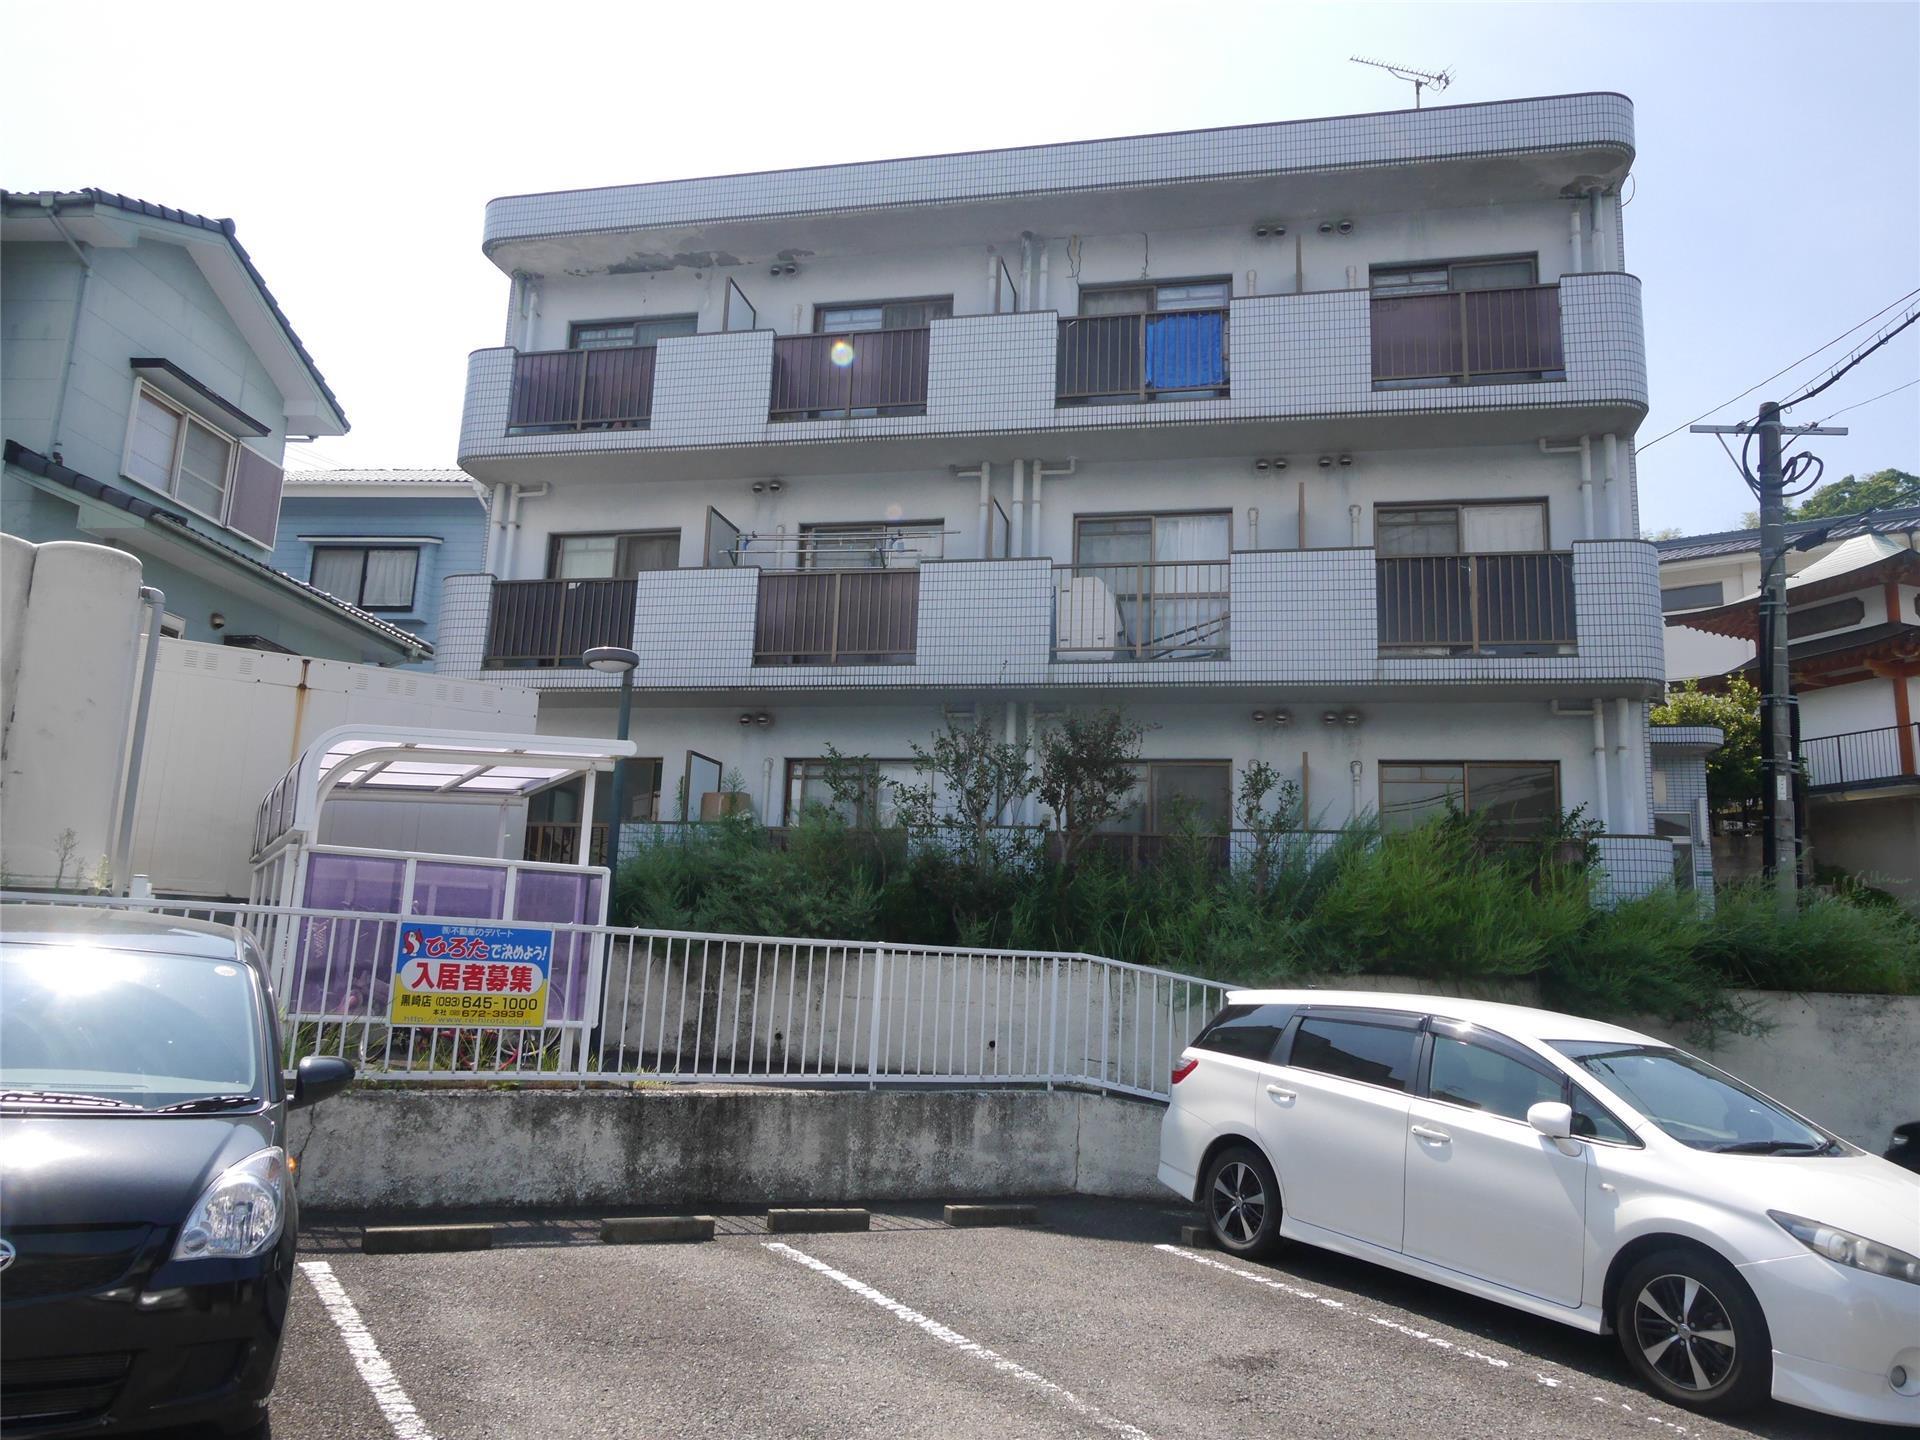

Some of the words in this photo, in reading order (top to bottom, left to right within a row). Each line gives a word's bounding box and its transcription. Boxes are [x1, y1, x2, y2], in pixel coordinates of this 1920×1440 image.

[411, 962, 533, 993] 入居者募集
[401, 994, 432, 1008] 黒崎店
